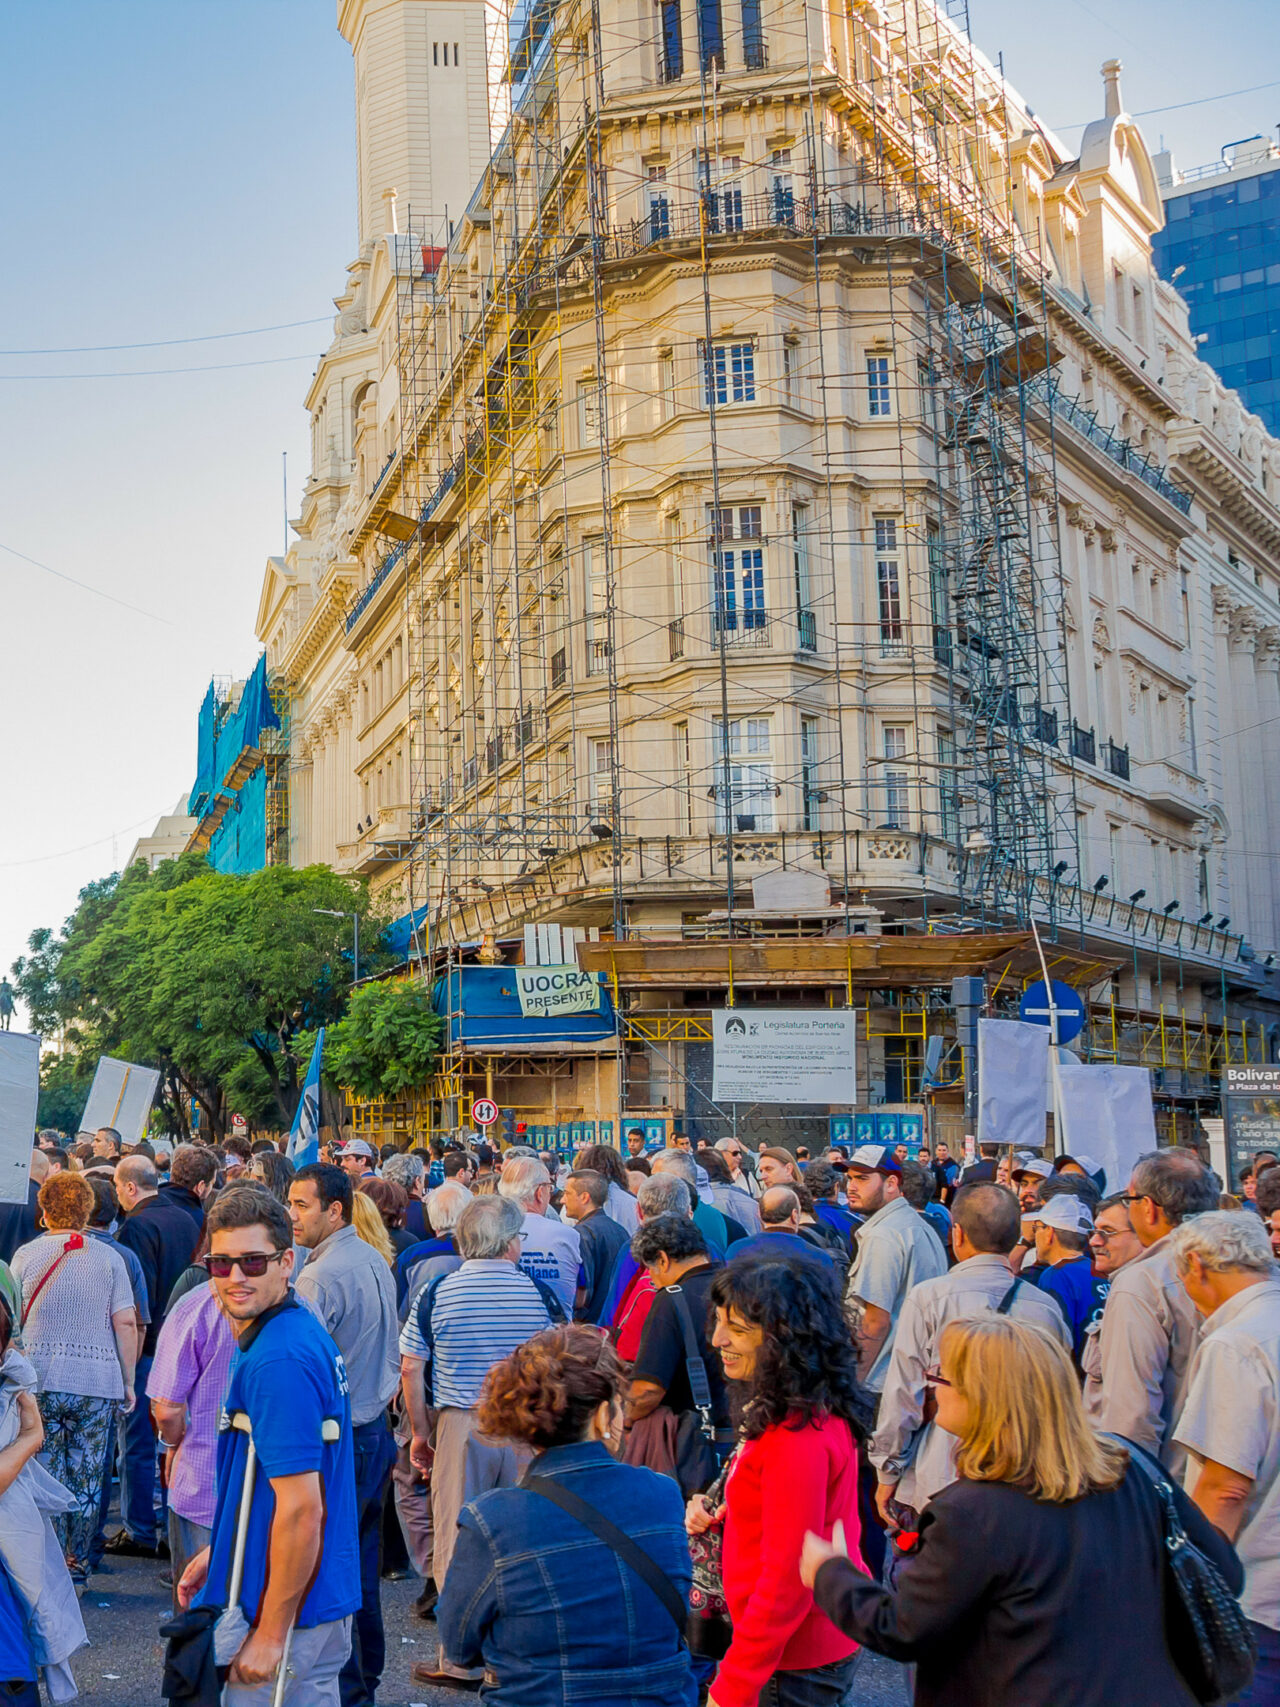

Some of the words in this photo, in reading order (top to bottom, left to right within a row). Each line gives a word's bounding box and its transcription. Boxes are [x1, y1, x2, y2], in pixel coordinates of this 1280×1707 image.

[521, 971, 593, 994] UOCRA
[526, 989, 593, 1009] PRESENTE
[763, 1020, 810, 1031] Legislatura
[812, 1020, 845, 1030] Porteña
[1227, 1068, 1280, 1081] Bolívar
[1236, 1083, 1259, 1091] Plaza
[1260, 1083, 1271, 1091] de
[523, 1265, 560, 1279] Blanca
